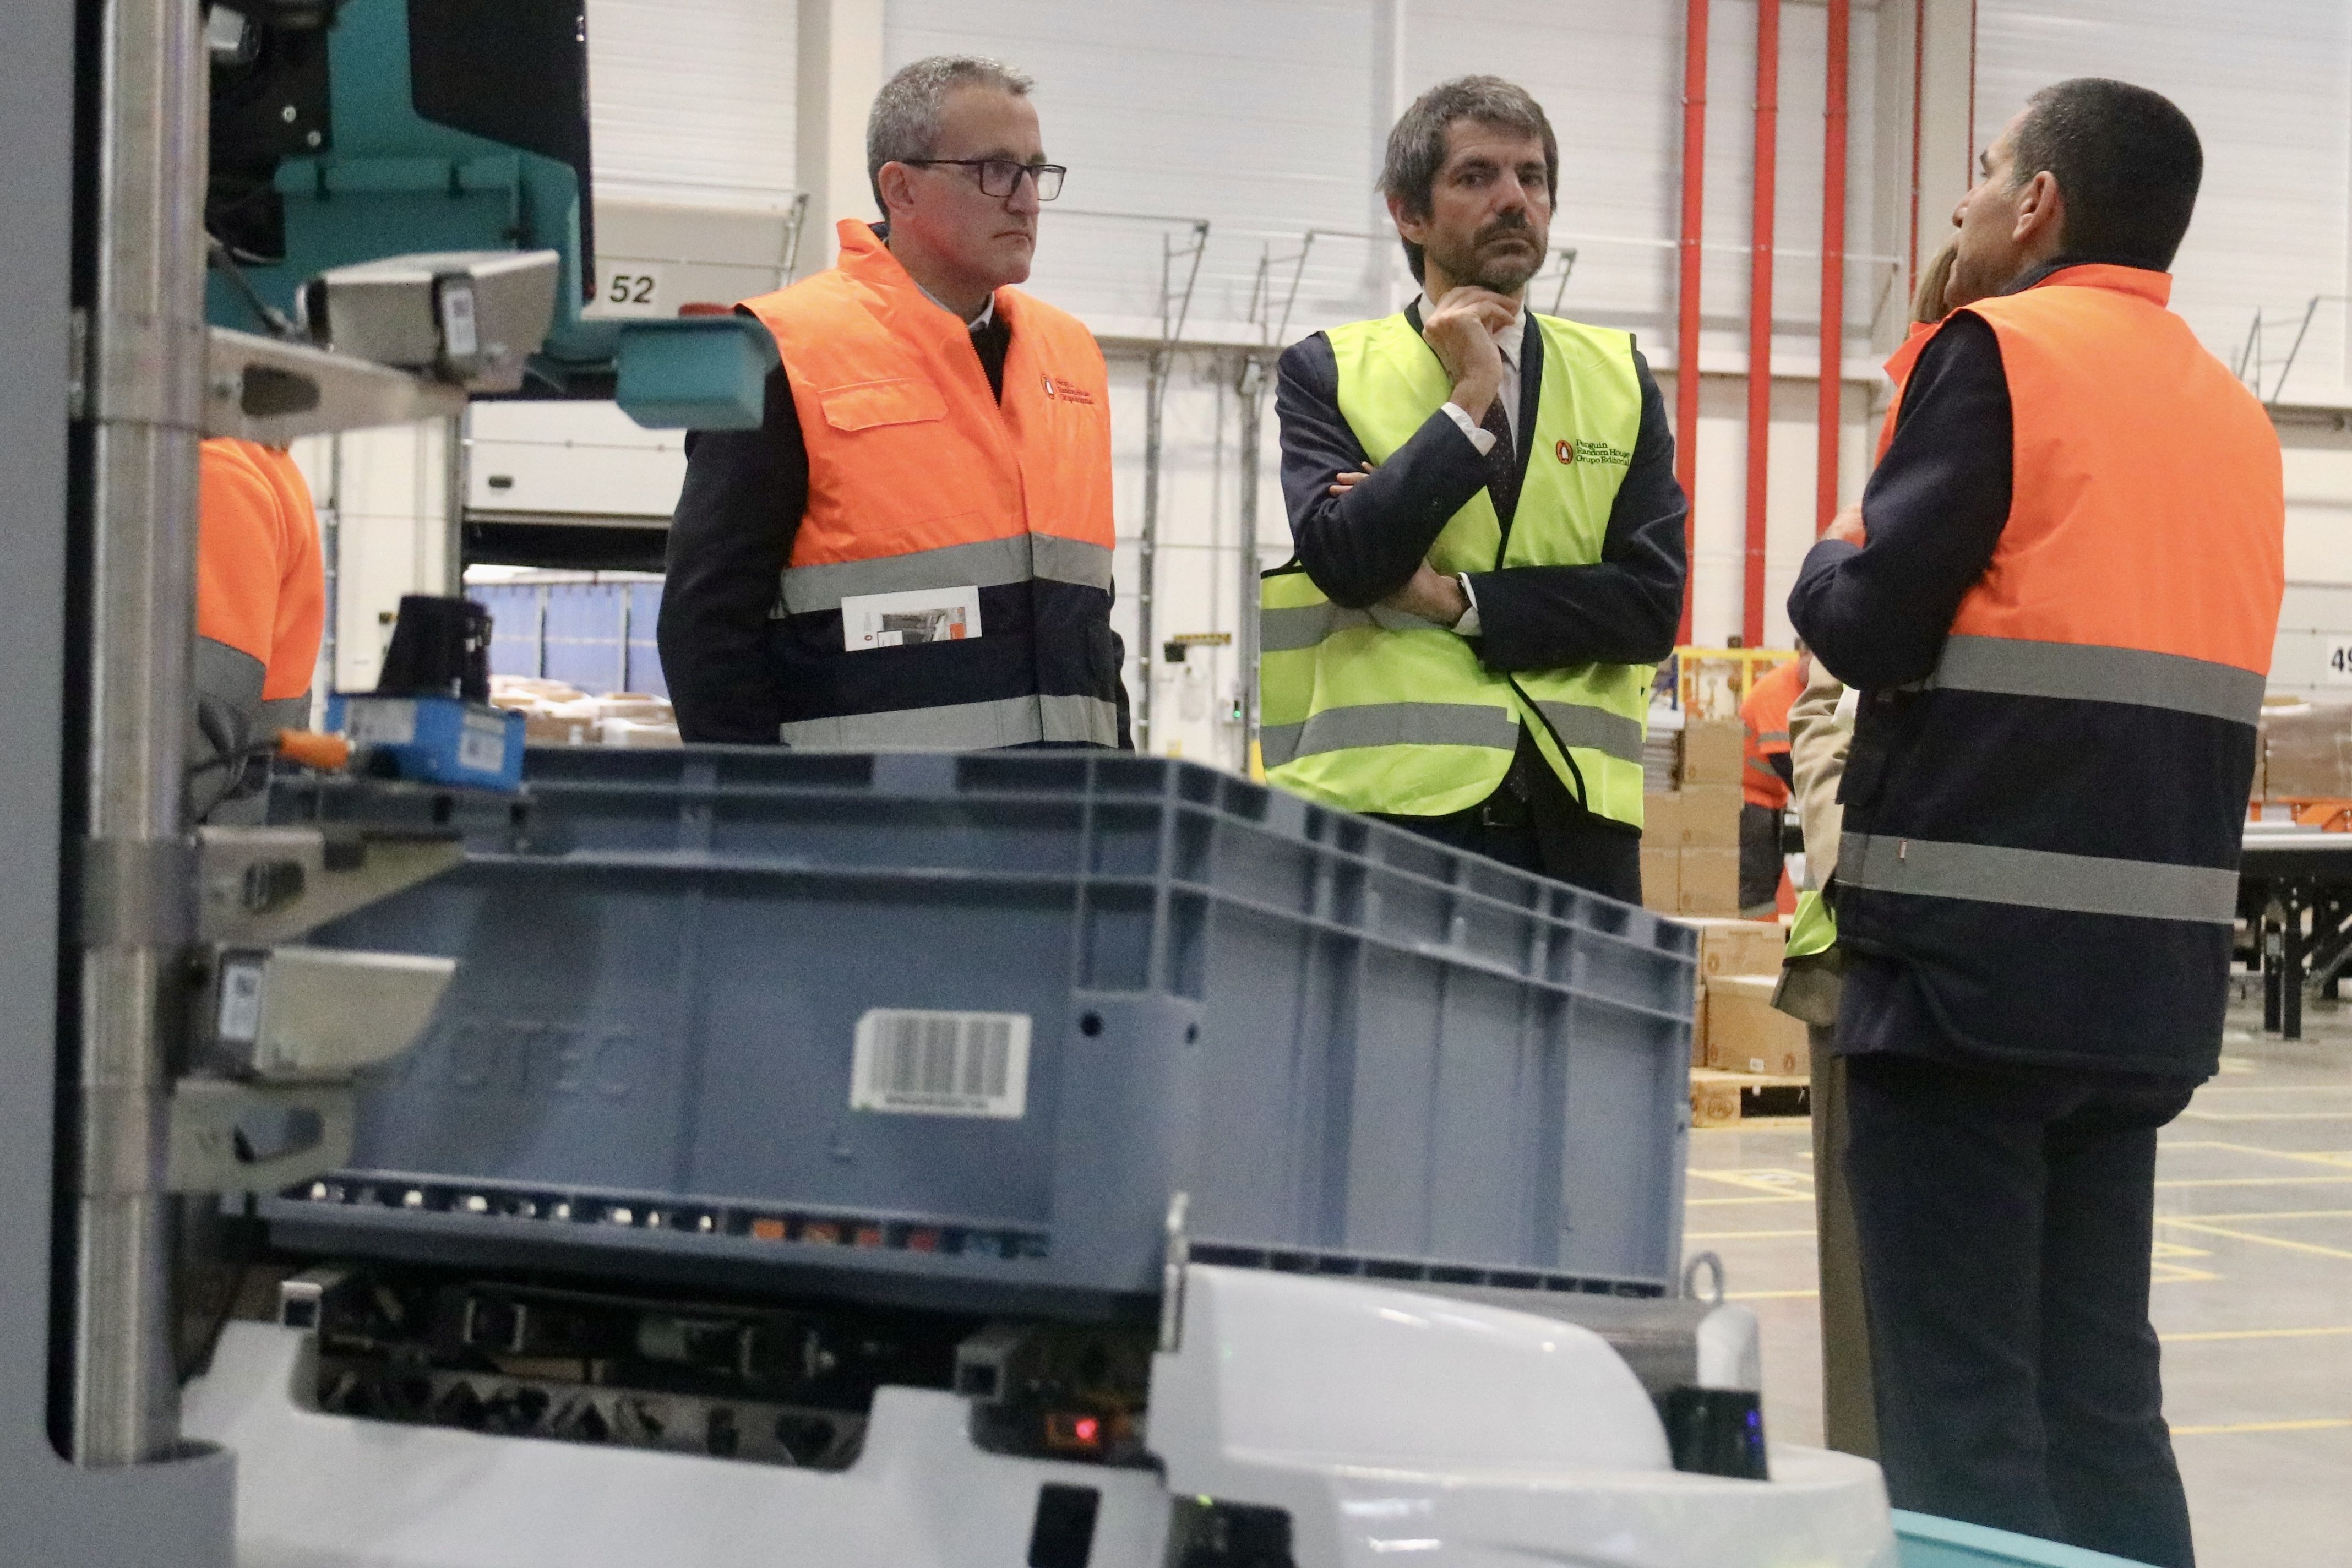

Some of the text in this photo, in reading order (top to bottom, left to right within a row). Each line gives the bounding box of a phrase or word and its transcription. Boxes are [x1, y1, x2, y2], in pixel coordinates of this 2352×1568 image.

[609, 276, 654, 302] 52
[1576, 439, 1608, 450] Penguin
[1609, 449, 1630, 458] House
[1576, 455, 1629, 466] Grupo Editorial
